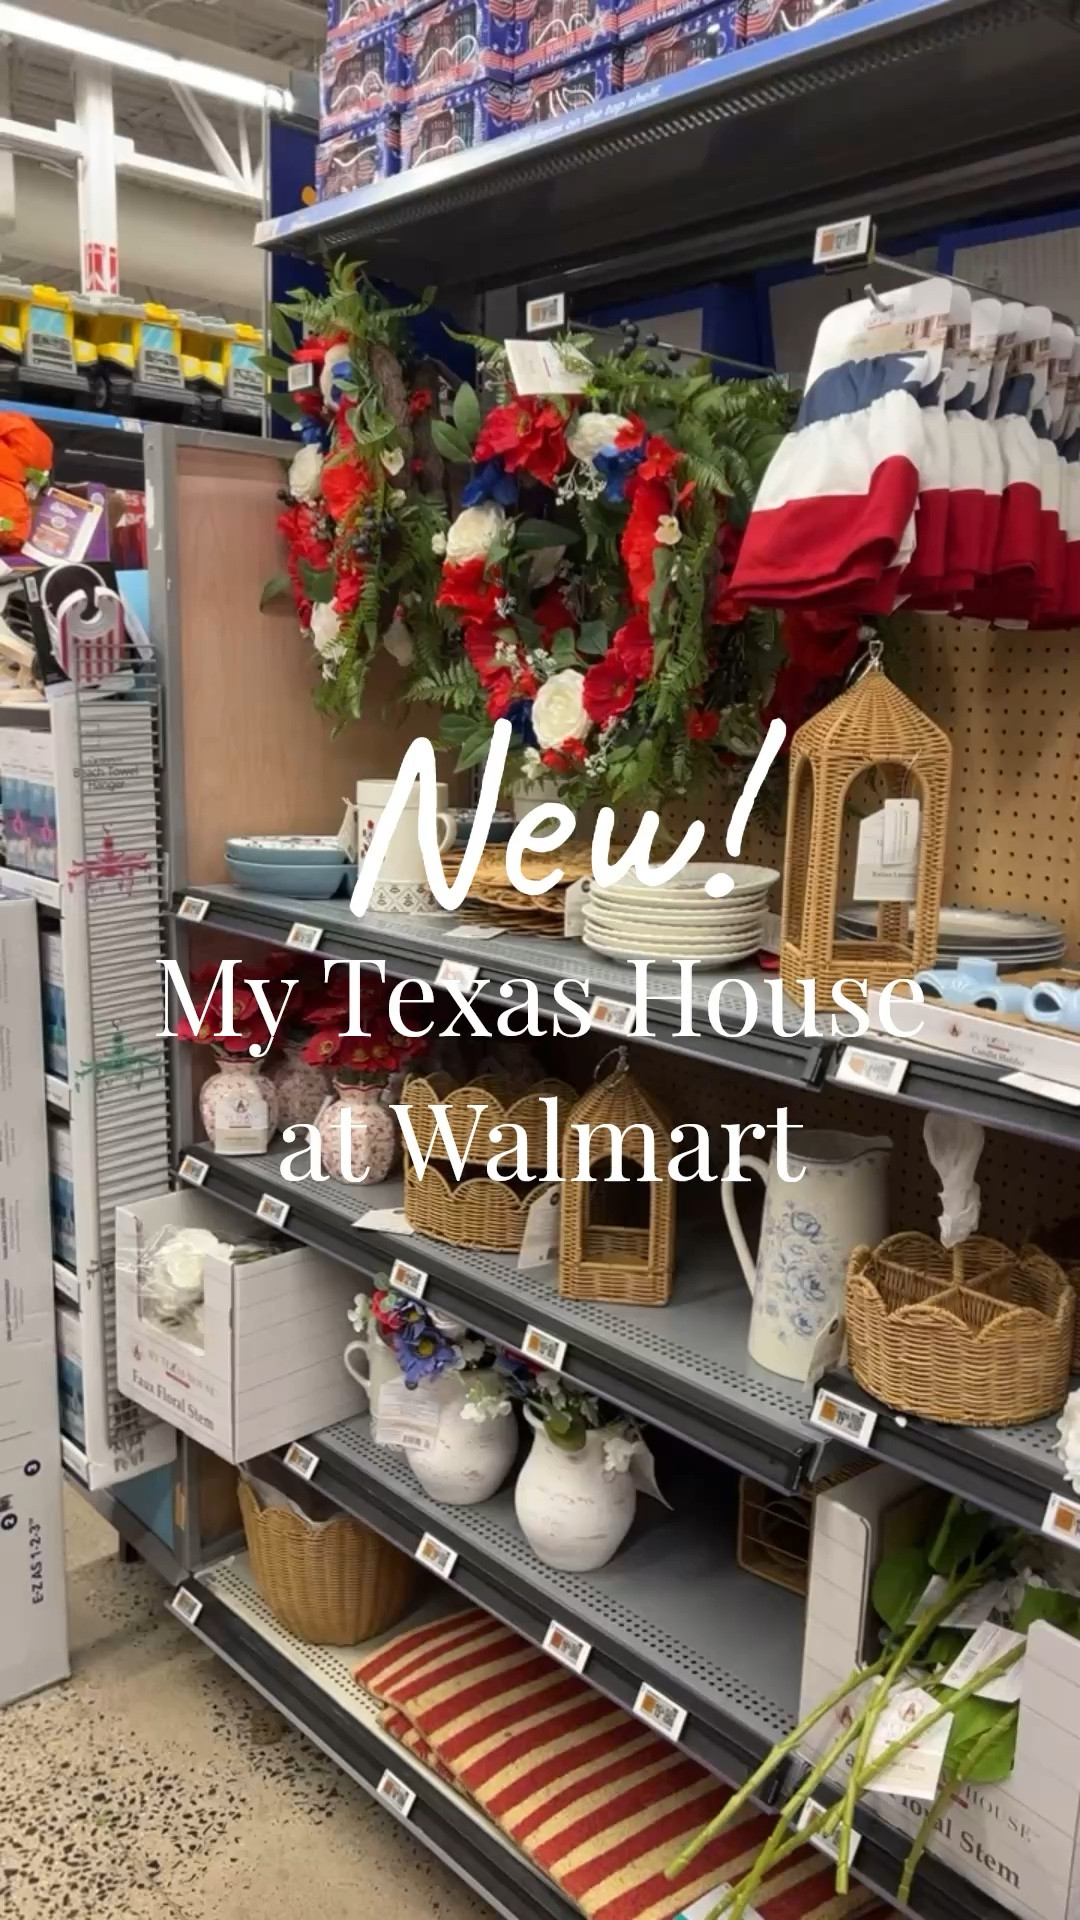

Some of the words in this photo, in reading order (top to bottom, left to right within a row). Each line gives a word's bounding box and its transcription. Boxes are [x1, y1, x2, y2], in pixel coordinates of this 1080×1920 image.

[157, 1383, 185, 1414] Floral
[187, 1403, 215, 1431] Stem
[30, 1561, 43, 1579] AS
[959, 1830, 1021, 1890] Stem
